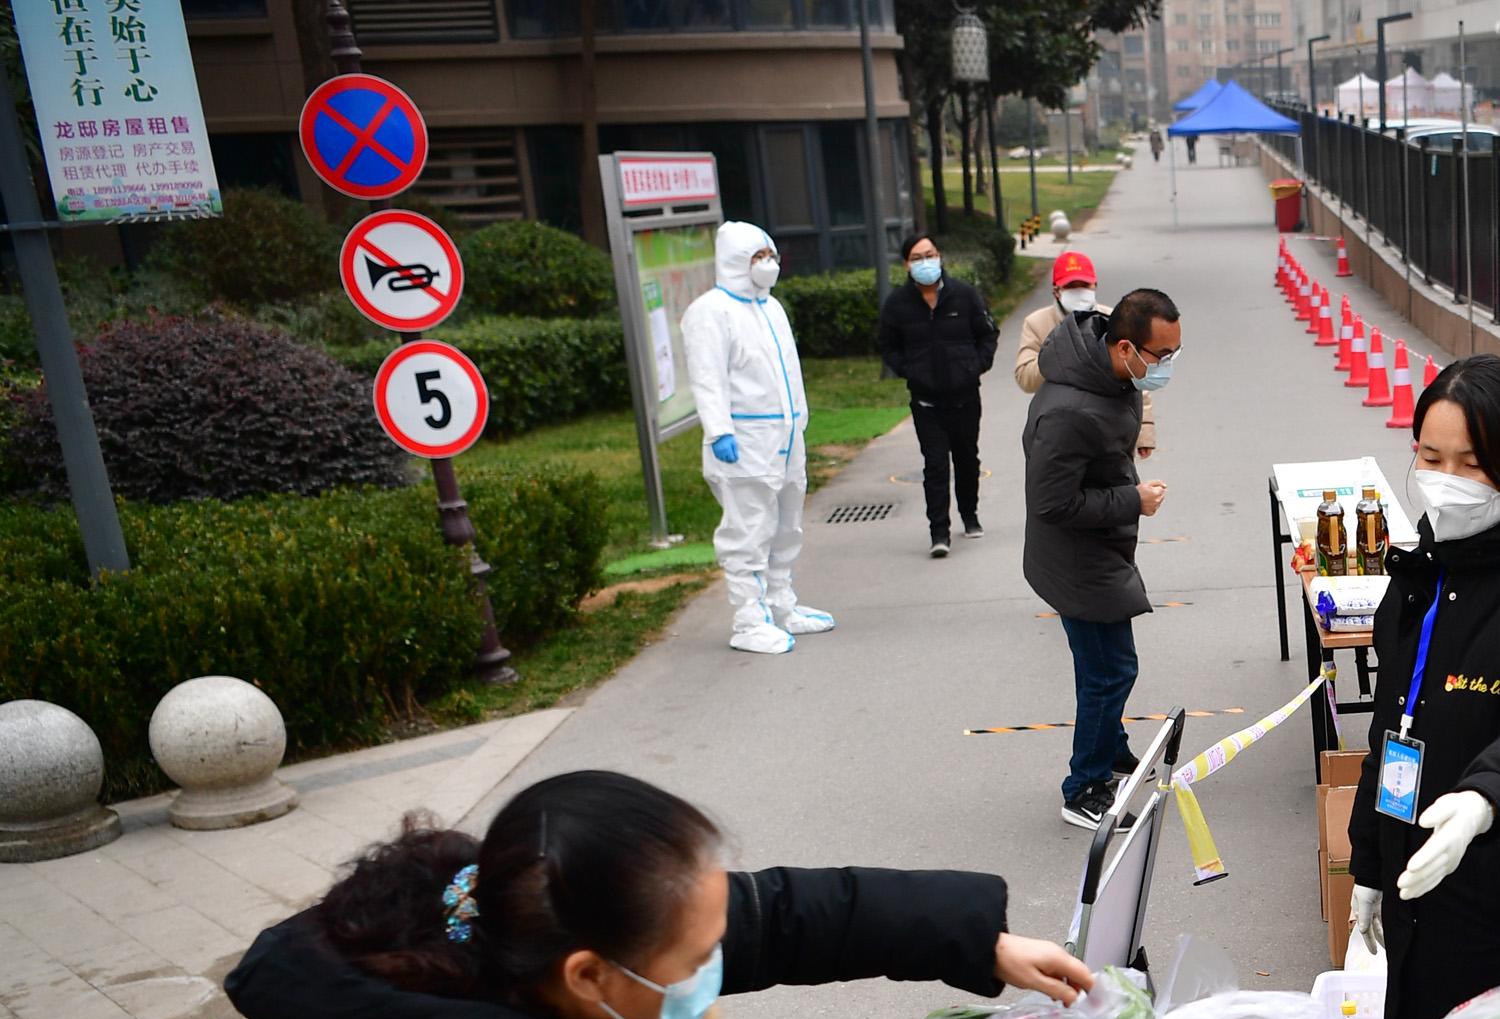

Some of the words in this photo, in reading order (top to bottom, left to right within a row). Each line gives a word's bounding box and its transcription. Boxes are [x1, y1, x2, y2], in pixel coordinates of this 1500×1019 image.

[54, 116, 190, 139] 龙邸房屋租售
[59, 144, 125, 161] 房源登记
[133, 140, 196, 157] 房产交易
[63, 163, 127, 181] 租赁代理
[136, 159, 199, 177] 代办手续
[414, 369, 452, 430] 5
